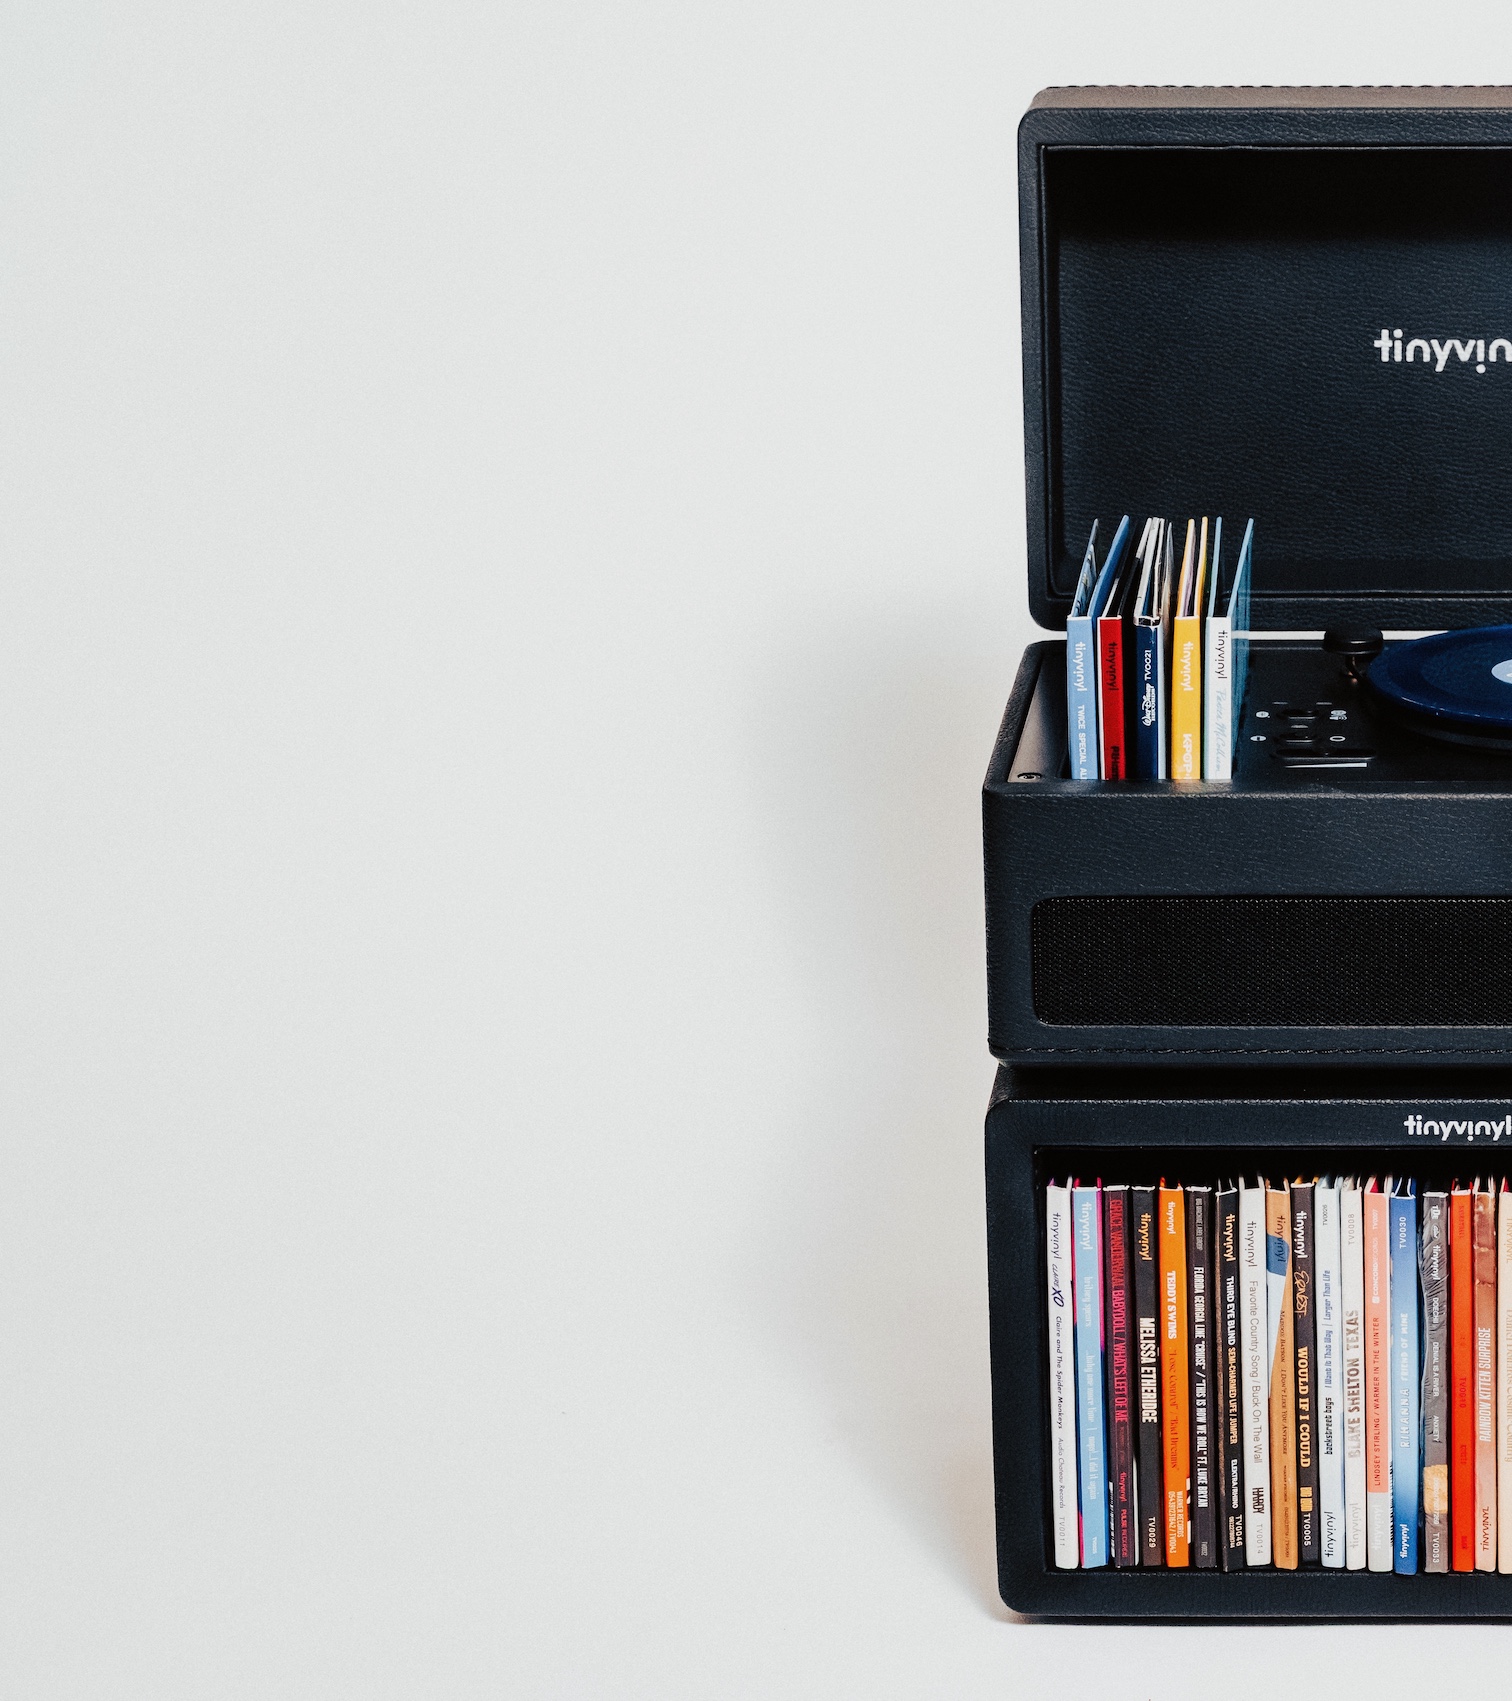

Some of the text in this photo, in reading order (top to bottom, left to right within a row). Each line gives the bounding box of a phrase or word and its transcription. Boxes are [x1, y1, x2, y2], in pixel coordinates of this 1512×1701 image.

[1073, 642, 1087, 691] tinyvinyl
[1106, 642, 1119, 690] tinyvinyl
[1181, 642, 1193, 691] tinyvinyl
[1215, 630, 1227, 678] tinyvinyl
[1078, 733, 1086, 764] SPECIAL
[1404, 1115, 1512, 1141] tinyvinyl
[1050, 1213, 1062, 1259] tinyvinyl
[1079, 1202, 1093, 1249] tinyvinyl
[1138, 1213, 1152, 1260] tinyvinyl
[1166, 1201, 1176, 1235] tinyvinyl
[1223, 1214, 1236, 1261] tinyvinyl
[1293, 1211, 1308, 1258] tinyvinyl
[1399, 1217, 1407, 1249] TV0030
[1244, 1221, 1257, 1267] tinyvinyl
[1274, 1216, 1286, 1262] tinyvinyl
[1194, 1267, 1204, 1293] FLORIDA
[1431, 1245, 1441, 1280] tinyvinyl
[1112, 1290, 1125, 1335] BABYDOLL
[1167, 1271, 1176, 1339] TEDDY SWIMS
[1194, 1296, 1204, 1323] GEORGIA
[1226, 1276, 1235, 1345] THIRD EYE BLIND
[1195, 1325, 1205, 1338] LINE
[1113, 1343, 1126, 1375] WHAT'S
[1140, 1318, 1157, 1423] MELISSA ETHERIDGE
[1229, 1348, 1237, 1398] SEMI-CHARMED
[1248, 1281, 1262, 1463] Favorite Country Song Buck On The Wall
[1297, 1346, 1309, 1394] WOULD
[1115, 1378, 1126, 1394] LEFT
[1115, 1397, 1127, 1409] OF
[1299, 1398, 1309, 1411] IF
[1346, 1310, 1361, 1458] BLAKE SHELTON TEXAS
[1478, 1327, 1491, 1442] RAINBOW KITTEN SURPRISE
[1116, 1411, 1127, 1423] ME
[1196, 1408, 1207, 1423] HOW
[1229, 1399, 1237, 1413] LIFE
[1400, 1388, 1410, 1448] RIHANNA
[1197, 1425, 1207, 1435] WE
[1299, 1425, 1310, 1467] COULD
[1325, 1415, 1333, 1455] backstreet
[1197, 1457, 1207, 1466] FT.
[1198, 1468, 1208, 1485] LUKE
[1119, 1472, 1127, 1502] tinyvinyl
[1198, 1486, 1208, 1507] BRYAN
[1252, 1488, 1264, 1514] HARDY
[1303, 1513, 1311, 1546] TV0005
[1324, 1511, 1336, 1557] tinyvinyl
[1350, 1503, 1361, 1548] tinyvinyl
[1372, 1505, 1383, 1550] tinyvinyl
[1400, 1524, 1409, 1558] tinyvinyl
[1432, 1533, 1440, 1563] TV0033
